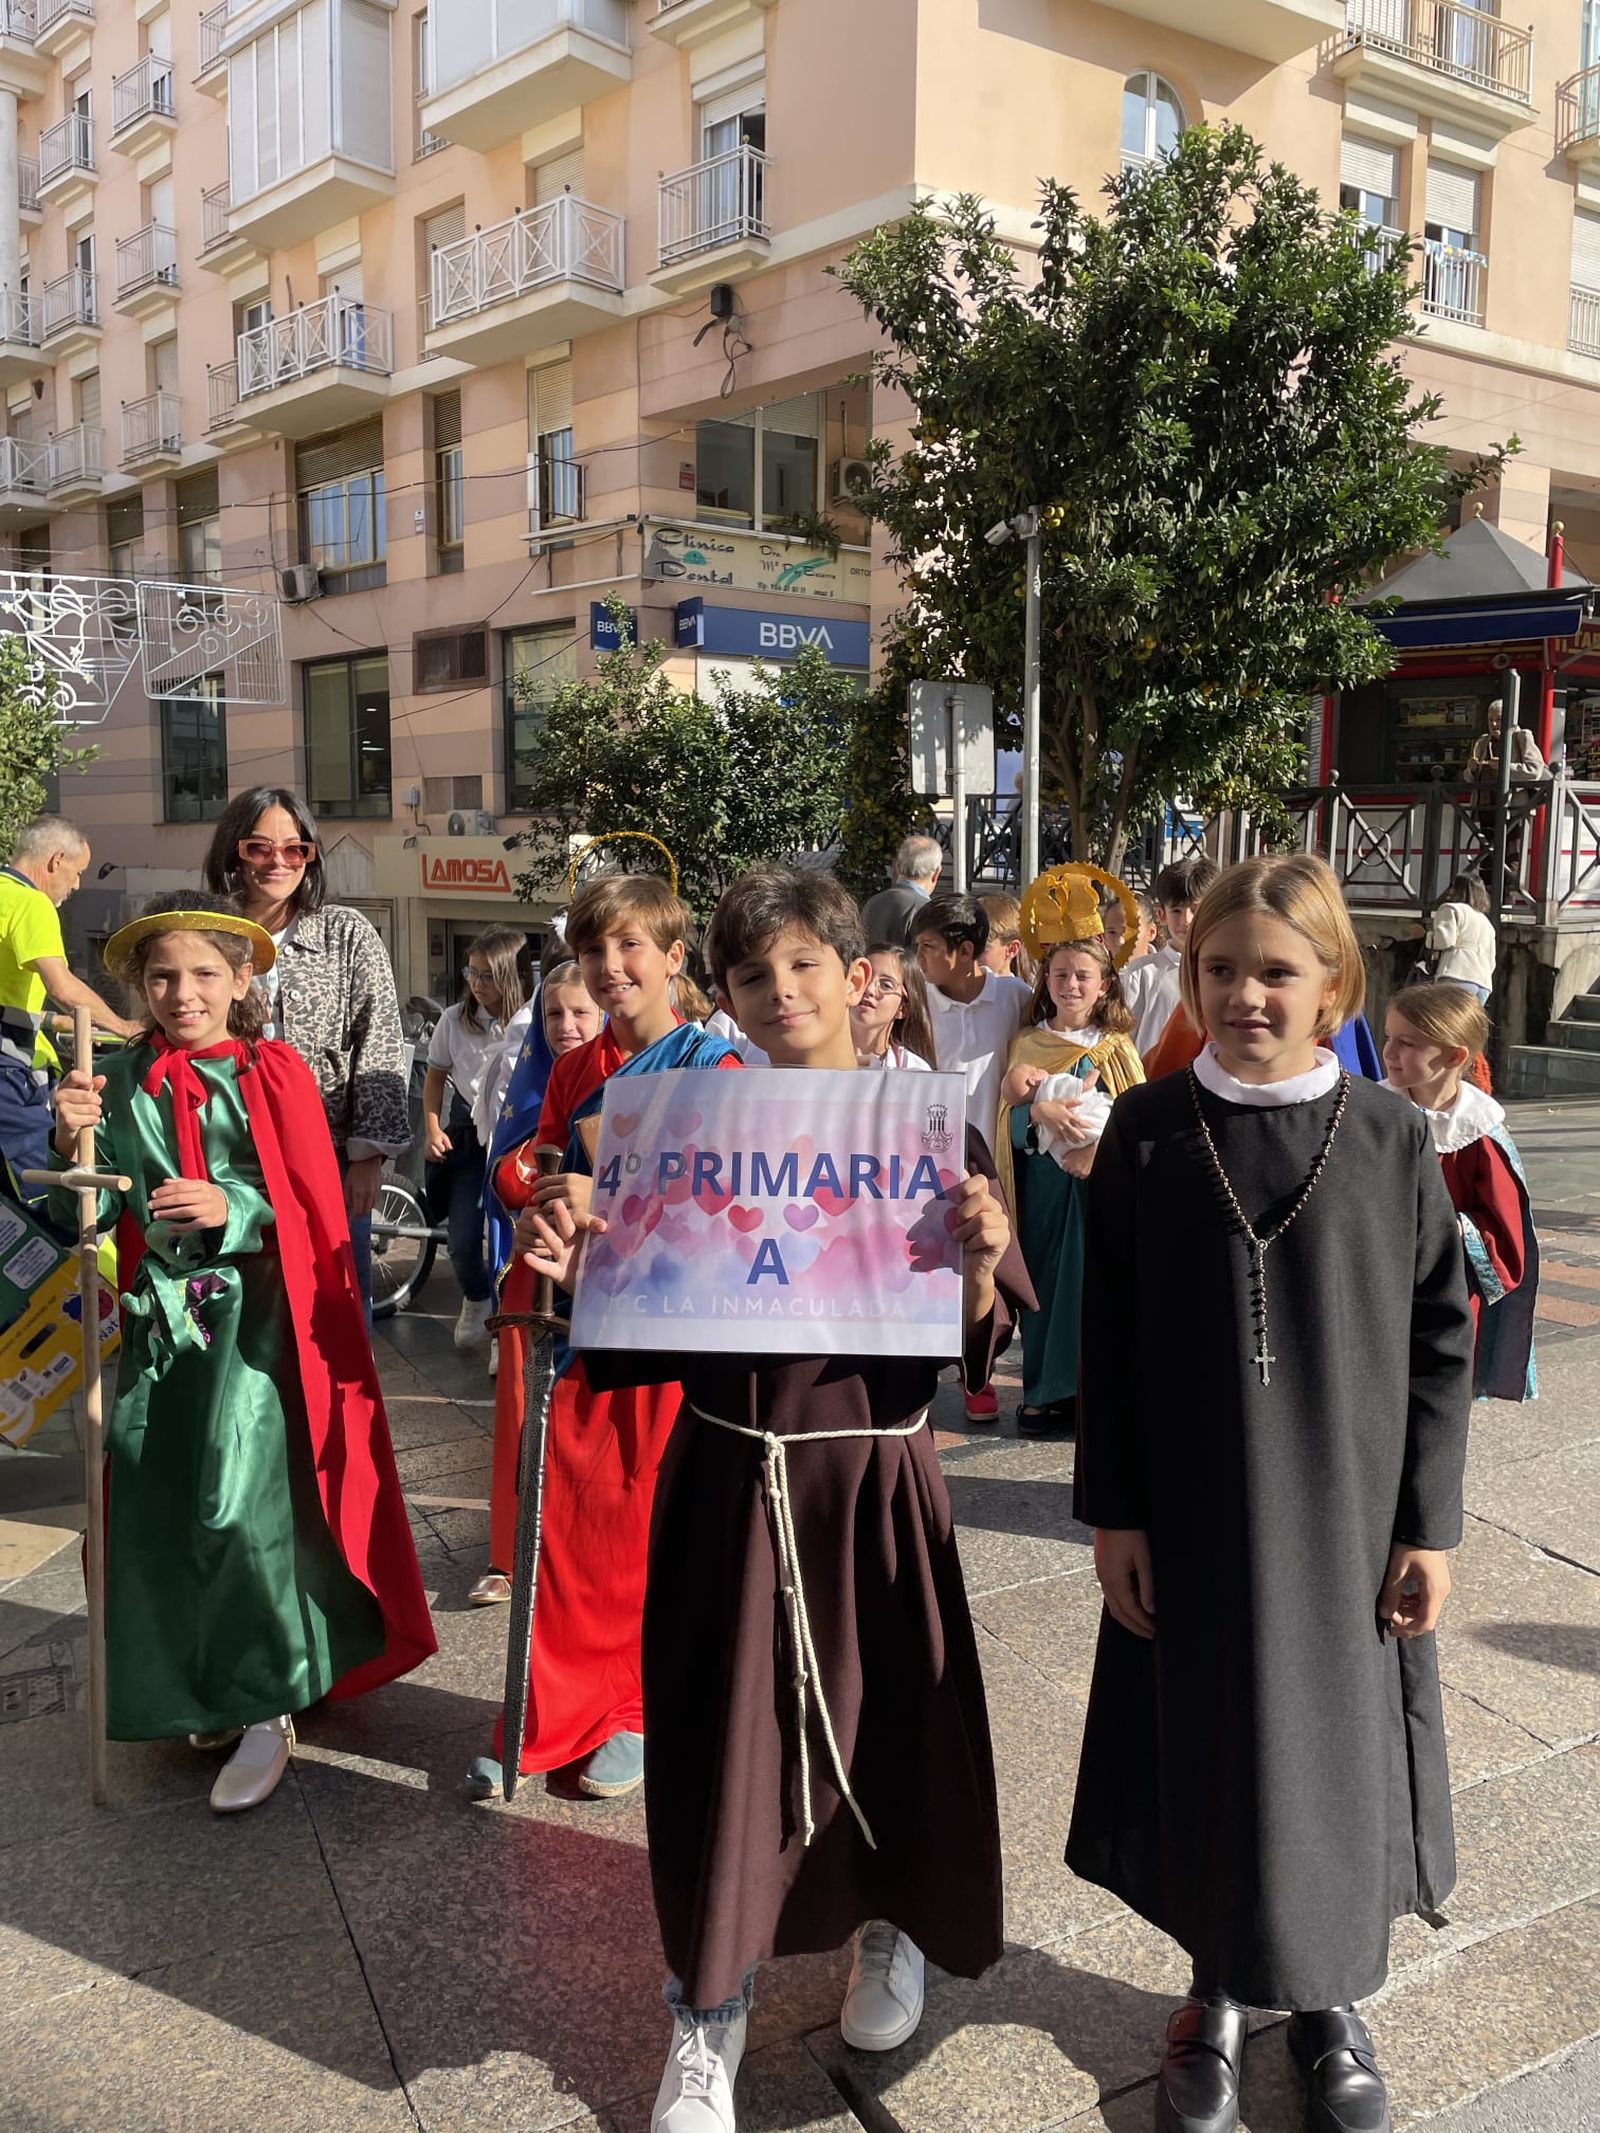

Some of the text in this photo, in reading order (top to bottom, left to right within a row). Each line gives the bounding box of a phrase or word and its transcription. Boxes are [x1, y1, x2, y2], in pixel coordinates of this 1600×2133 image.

[654, 561, 733, 585] Dental
[850, 567, 871, 577] ORTO
[678, 615, 696, 631] BBVA
[759, 622, 834, 649] BBVA
[422, 854, 511, 893] LAMOSA
[658, 1151, 946, 1201] PRIMARIA
[746, 1238, 790, 1286] A
[663, 1296, 695, 1314] LA
[712, 1297, 906, 1319] INMACULADA
